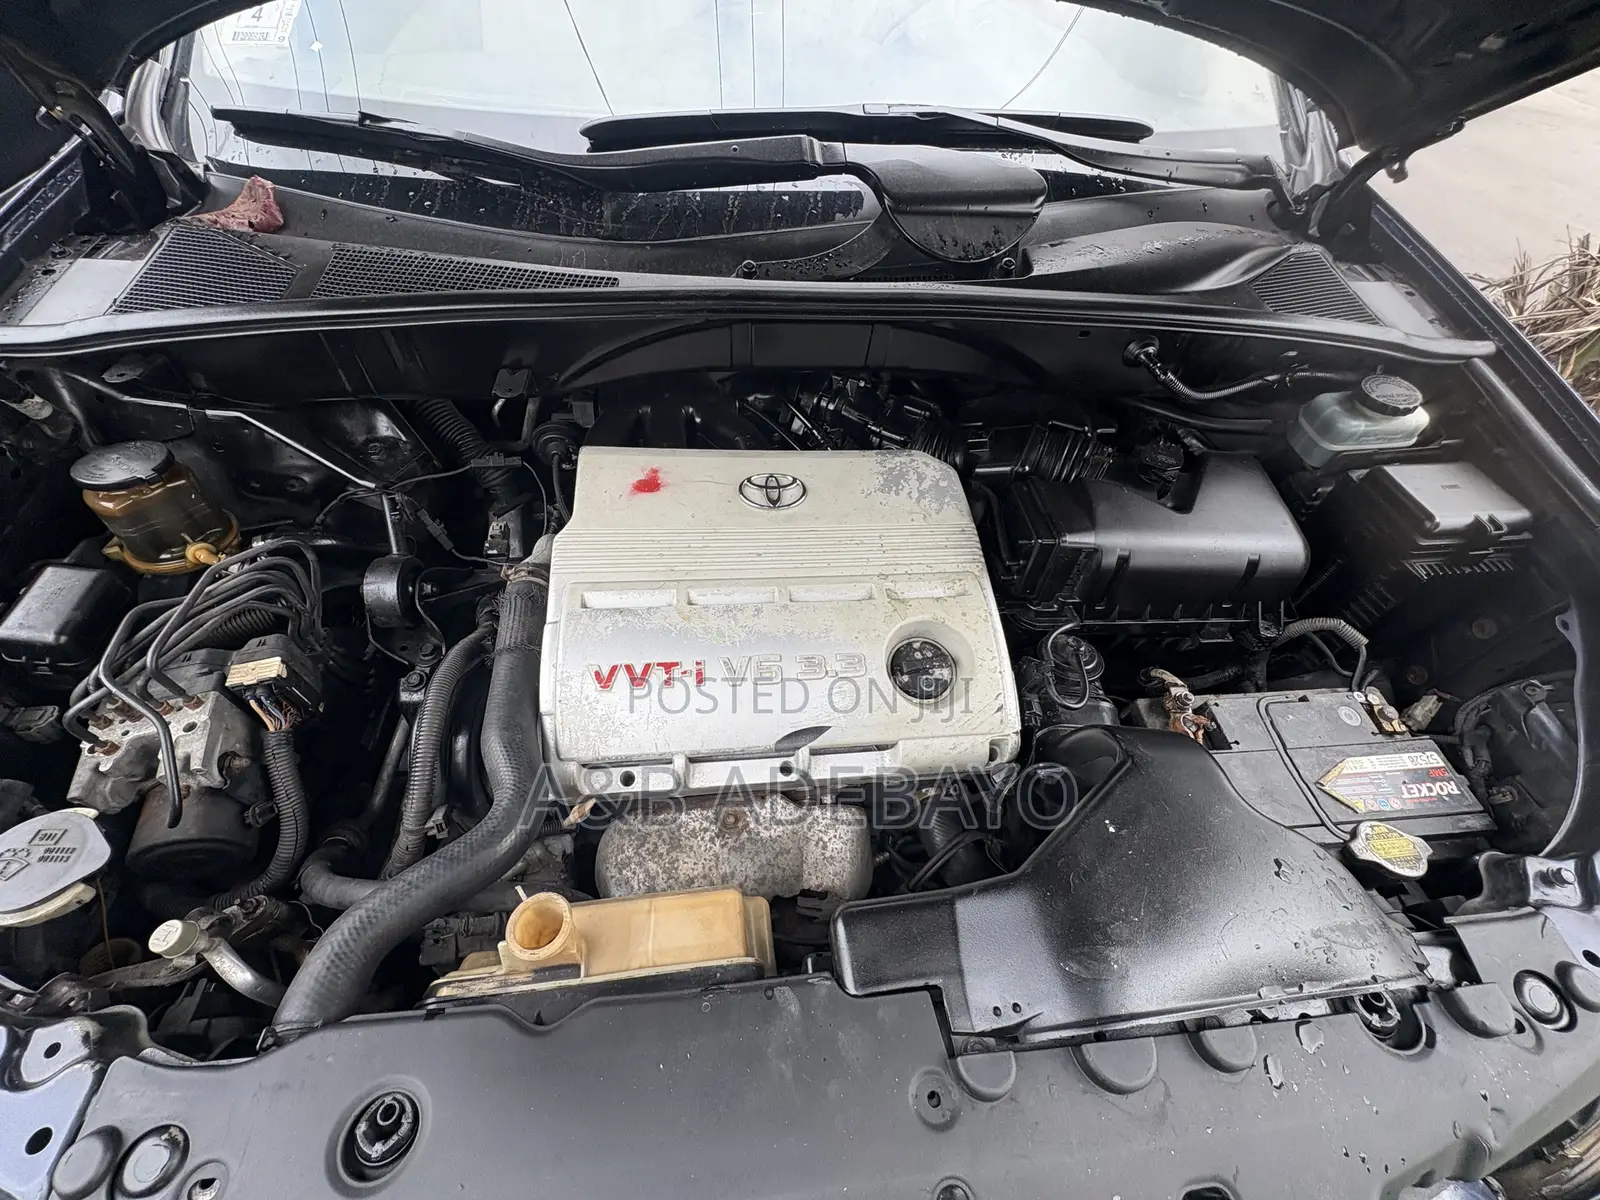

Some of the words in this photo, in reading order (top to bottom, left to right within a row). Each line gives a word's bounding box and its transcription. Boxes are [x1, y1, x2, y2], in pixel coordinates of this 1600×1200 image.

[587, 657, 707, 692] VVT-i
[717, 653, 785, 687] V6
[796, 652, 867, 681] 3.3
[1408, 755, 1440, 766] 57528
[1429, 768, 1448, 777] SMF
[1401, 781, 1460, 798] ROCKET
